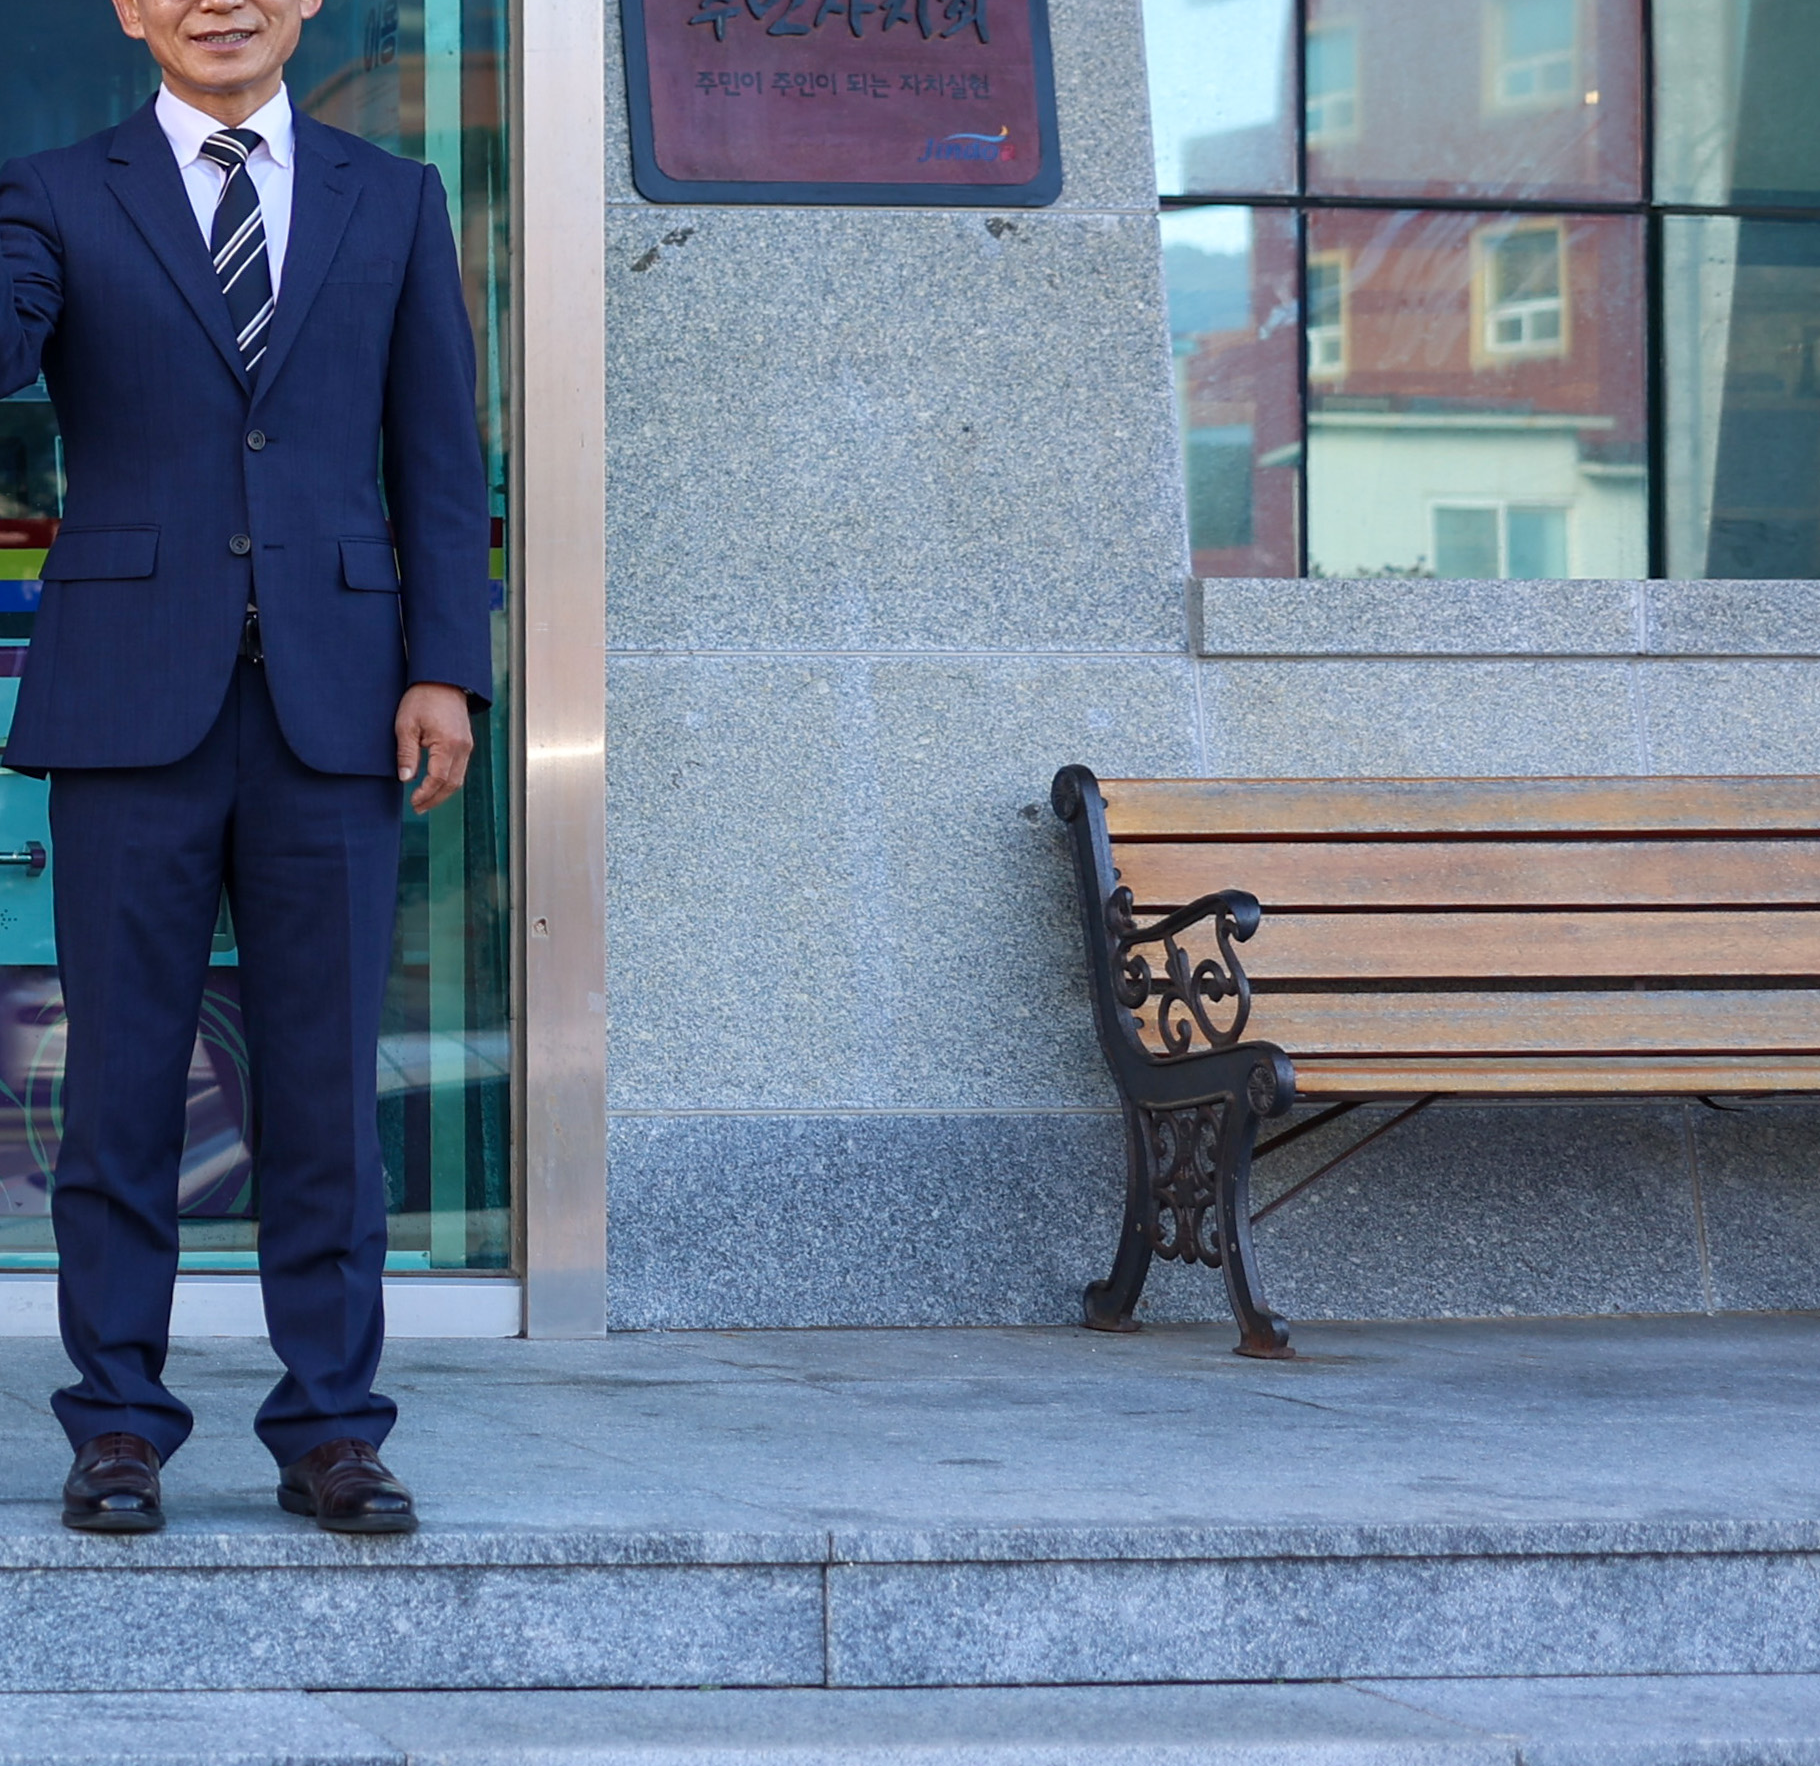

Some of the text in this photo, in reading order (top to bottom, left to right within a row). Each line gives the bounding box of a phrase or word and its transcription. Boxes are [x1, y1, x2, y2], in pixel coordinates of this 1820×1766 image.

[696, 71, 991, 100] 주민이 주인이 되는 자치실현
